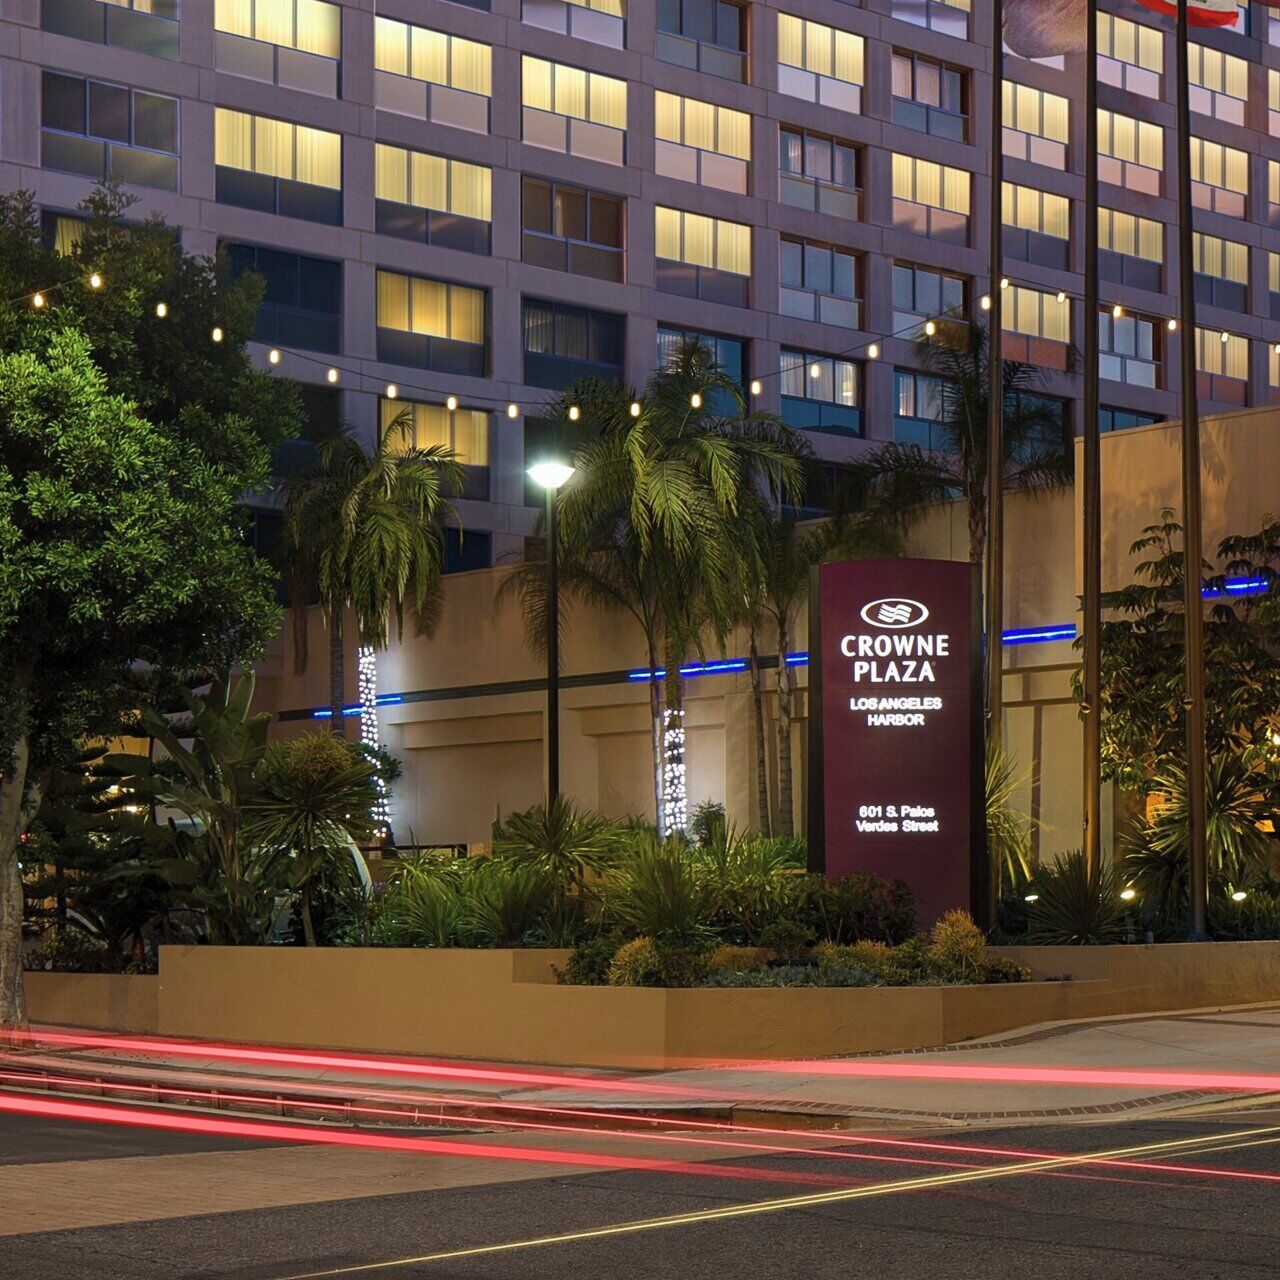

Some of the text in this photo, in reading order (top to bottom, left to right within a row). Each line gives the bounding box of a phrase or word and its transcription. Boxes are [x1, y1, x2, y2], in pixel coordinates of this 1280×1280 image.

[840, 634, 950, 657] CROWNE
[854, 660, 936, 682] PLAZA
[849, 697, 943, 710] LOS ANGELES
[867, 713, 925, 726] HARBOR
[859, 805, 935, 818] 601 S. Palos
[856, 820, 939, 832] Verdes Street
